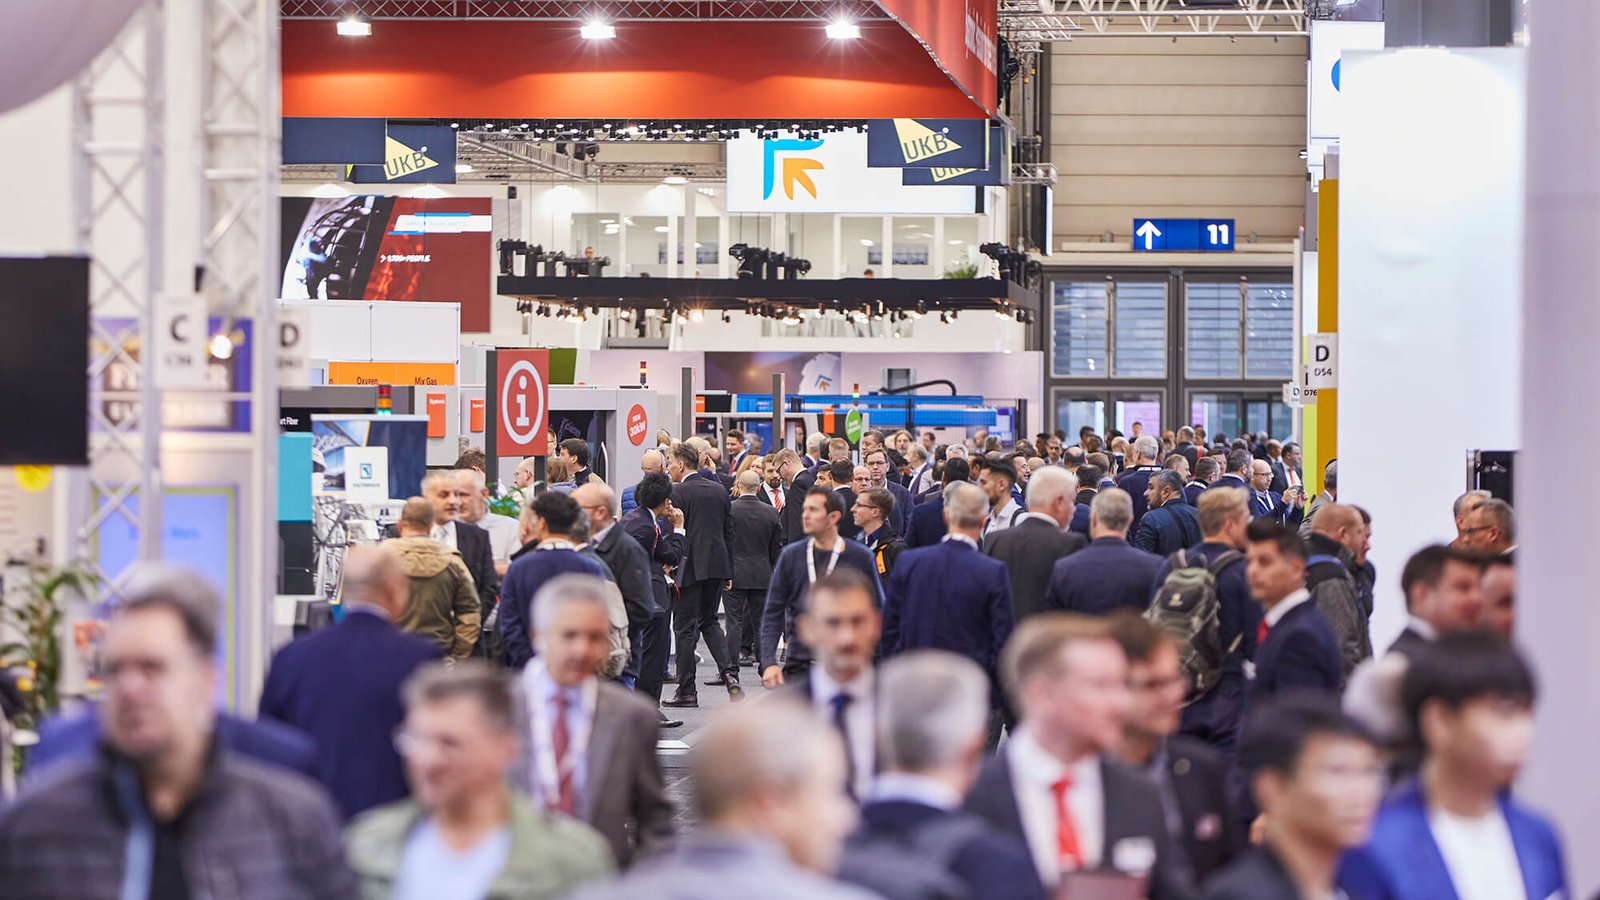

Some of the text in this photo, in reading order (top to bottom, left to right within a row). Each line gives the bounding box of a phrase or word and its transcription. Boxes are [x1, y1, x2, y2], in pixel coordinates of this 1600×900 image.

[904, 132, 948, 160] UKB
[386, 150, 426, 176] UKB
[1207, 224, 1229, 245] 11
[170, 313, 189, 343] C
[280, 322, 300, 348] D
[1315, 345, 1330, 362] D
[414, 377, 438, 386] Mix Gas
[1314, 367, 1333, 376] D54
[1304, 389, 1318, 397] D76
